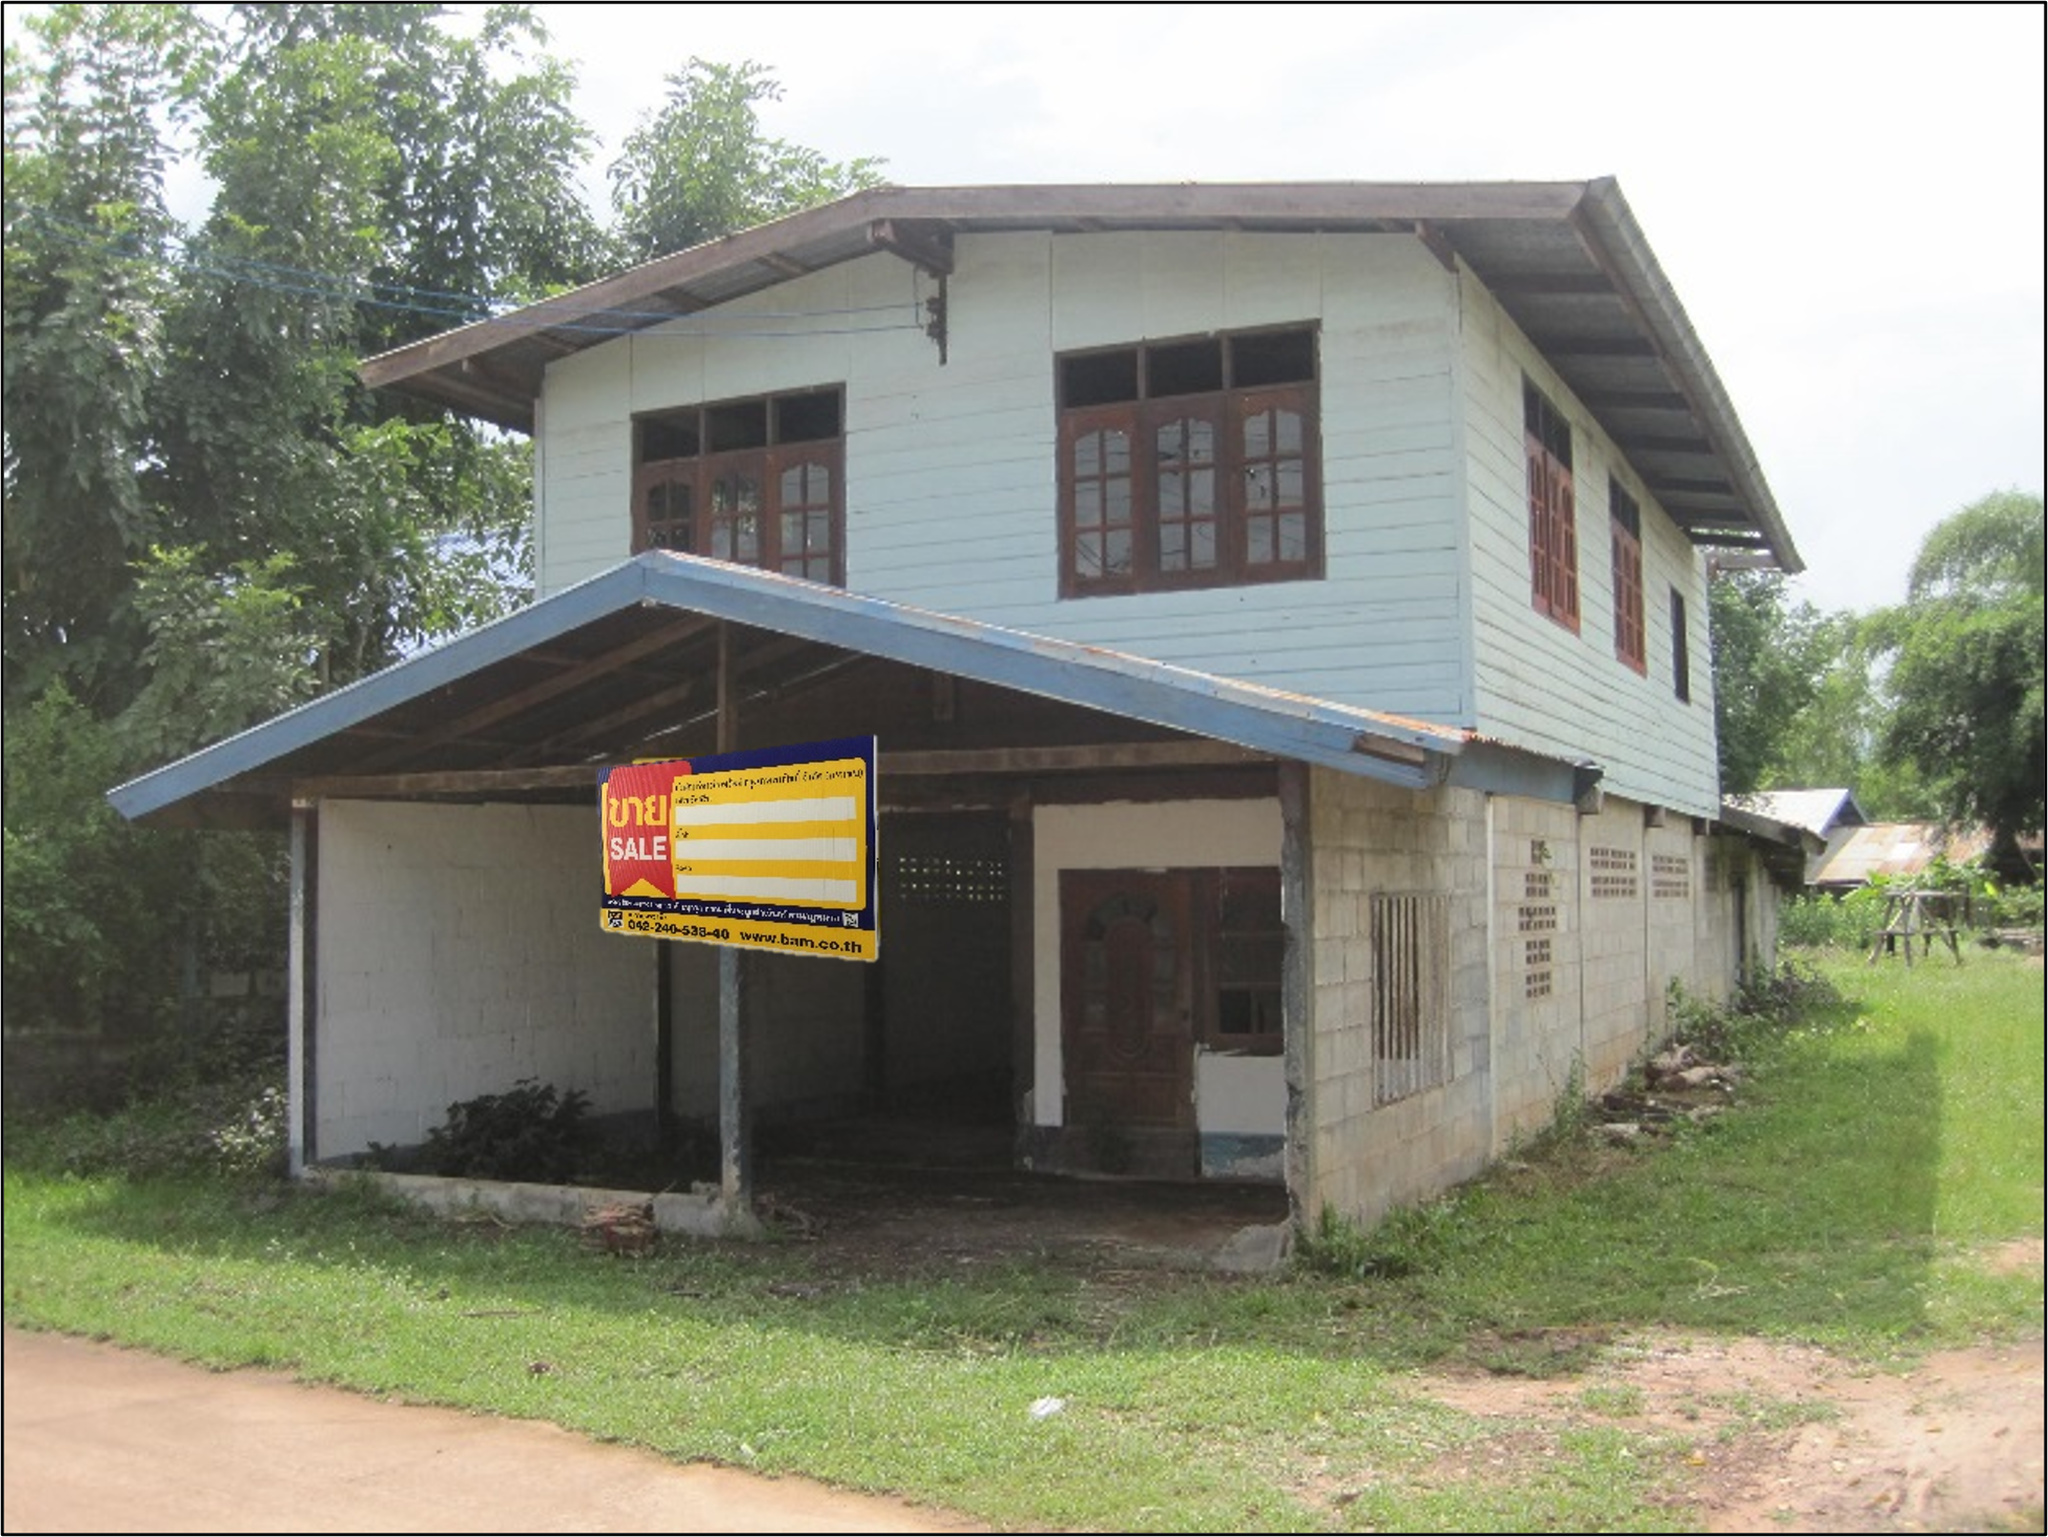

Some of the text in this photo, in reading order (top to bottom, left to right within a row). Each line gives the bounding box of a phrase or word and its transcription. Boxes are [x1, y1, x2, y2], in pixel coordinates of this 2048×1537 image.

[609, 795, 667, 827] ขาย
[610, 835, 667, 860] SALE
[628, 919, 729, 940] 042-240-538-40
[740, 931, 862, 953] www.bam.co.th
